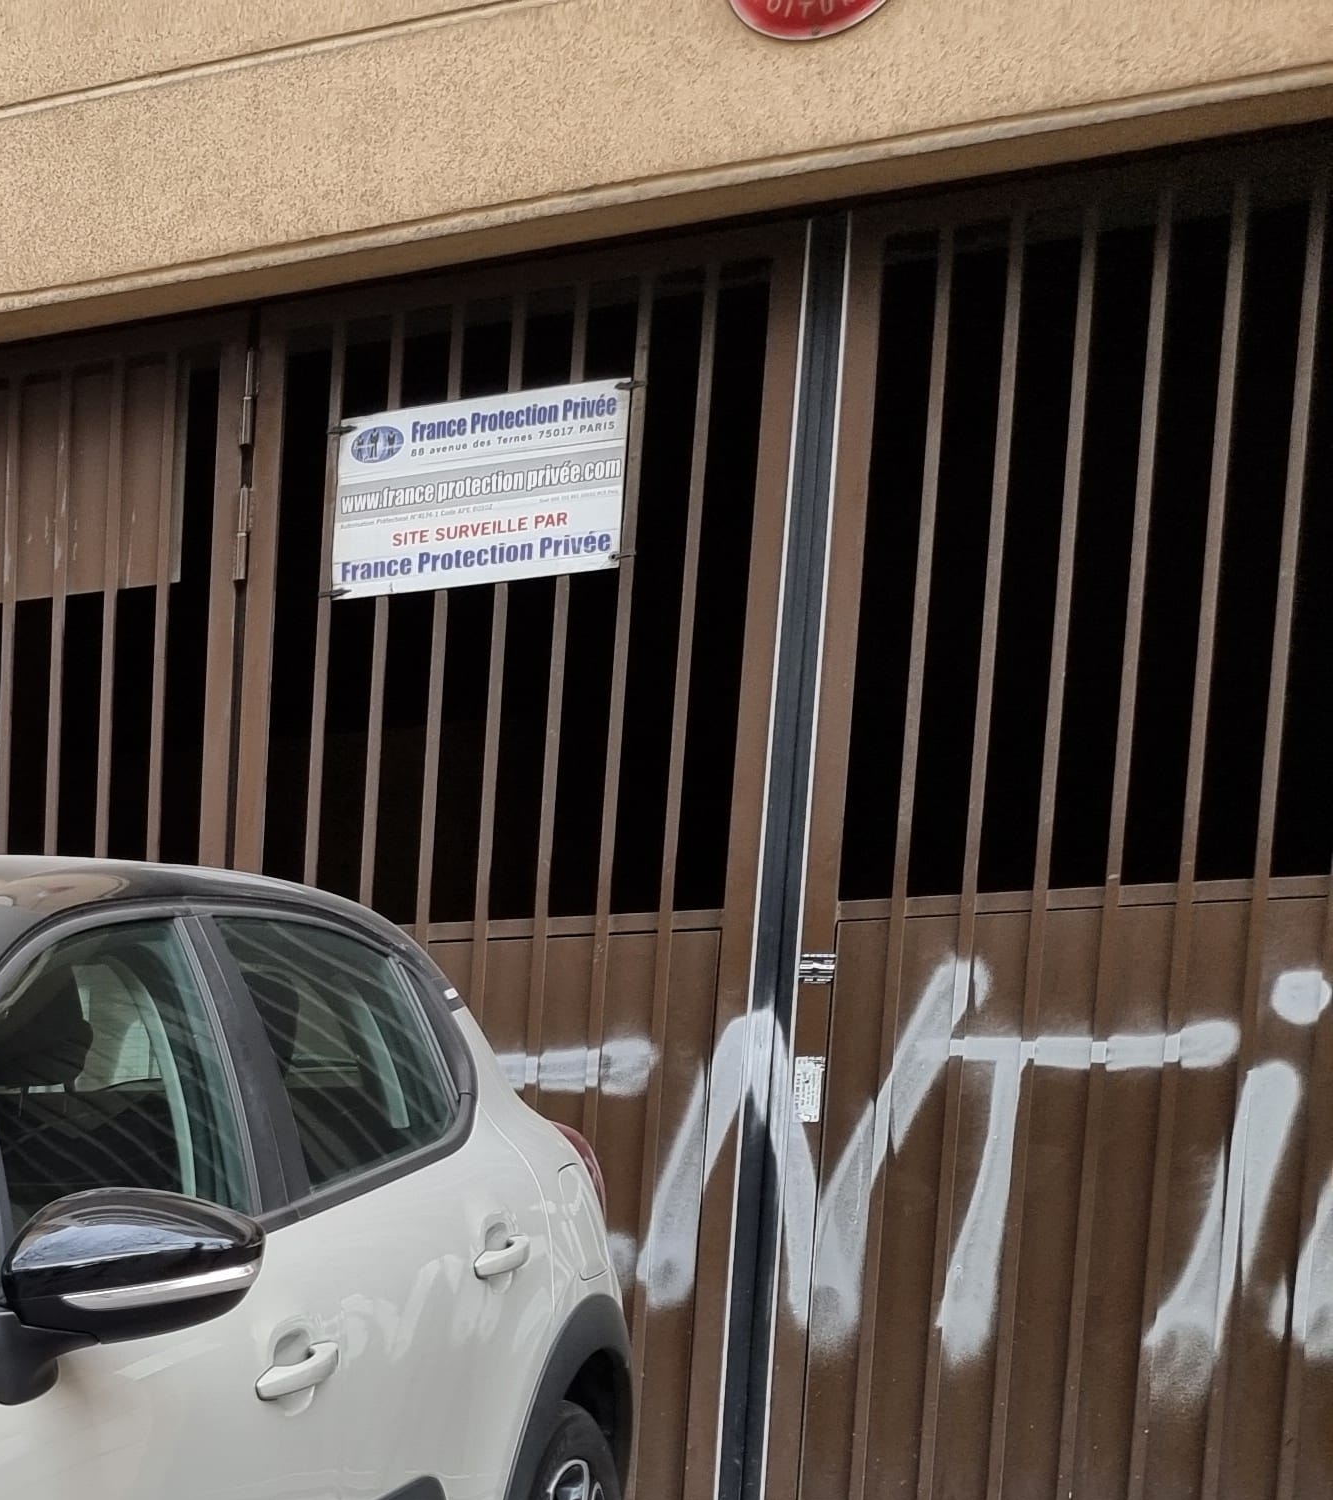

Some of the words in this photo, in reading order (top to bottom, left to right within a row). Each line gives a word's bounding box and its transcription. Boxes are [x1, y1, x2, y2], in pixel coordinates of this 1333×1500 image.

[411, 419, 466, 444] France
[470, 403, 559, 434] Protection
[562, 393, 617, 422] Privée
[429, 443, 468, 455] avenue
[472, 438, 492, 449] des
[497, 431, 533, 446] Ternes
[538, 426, 574, 439] 75017
[579, 420, 616, 434] PARIS
[340, 481, 435, 515] www.france
[437, 469, 525, 503] protection
[526, 457, 623, 492] privée.com
[392, 528, 430, 547] SITE
[435, 516, 528, 542] SURVEILLE
[534, 511, 568, 530] PAR
[341, 552, 412, 582] France
[418, 541, 533, 574] Protection
[539, 530, 611, 560] Privée
